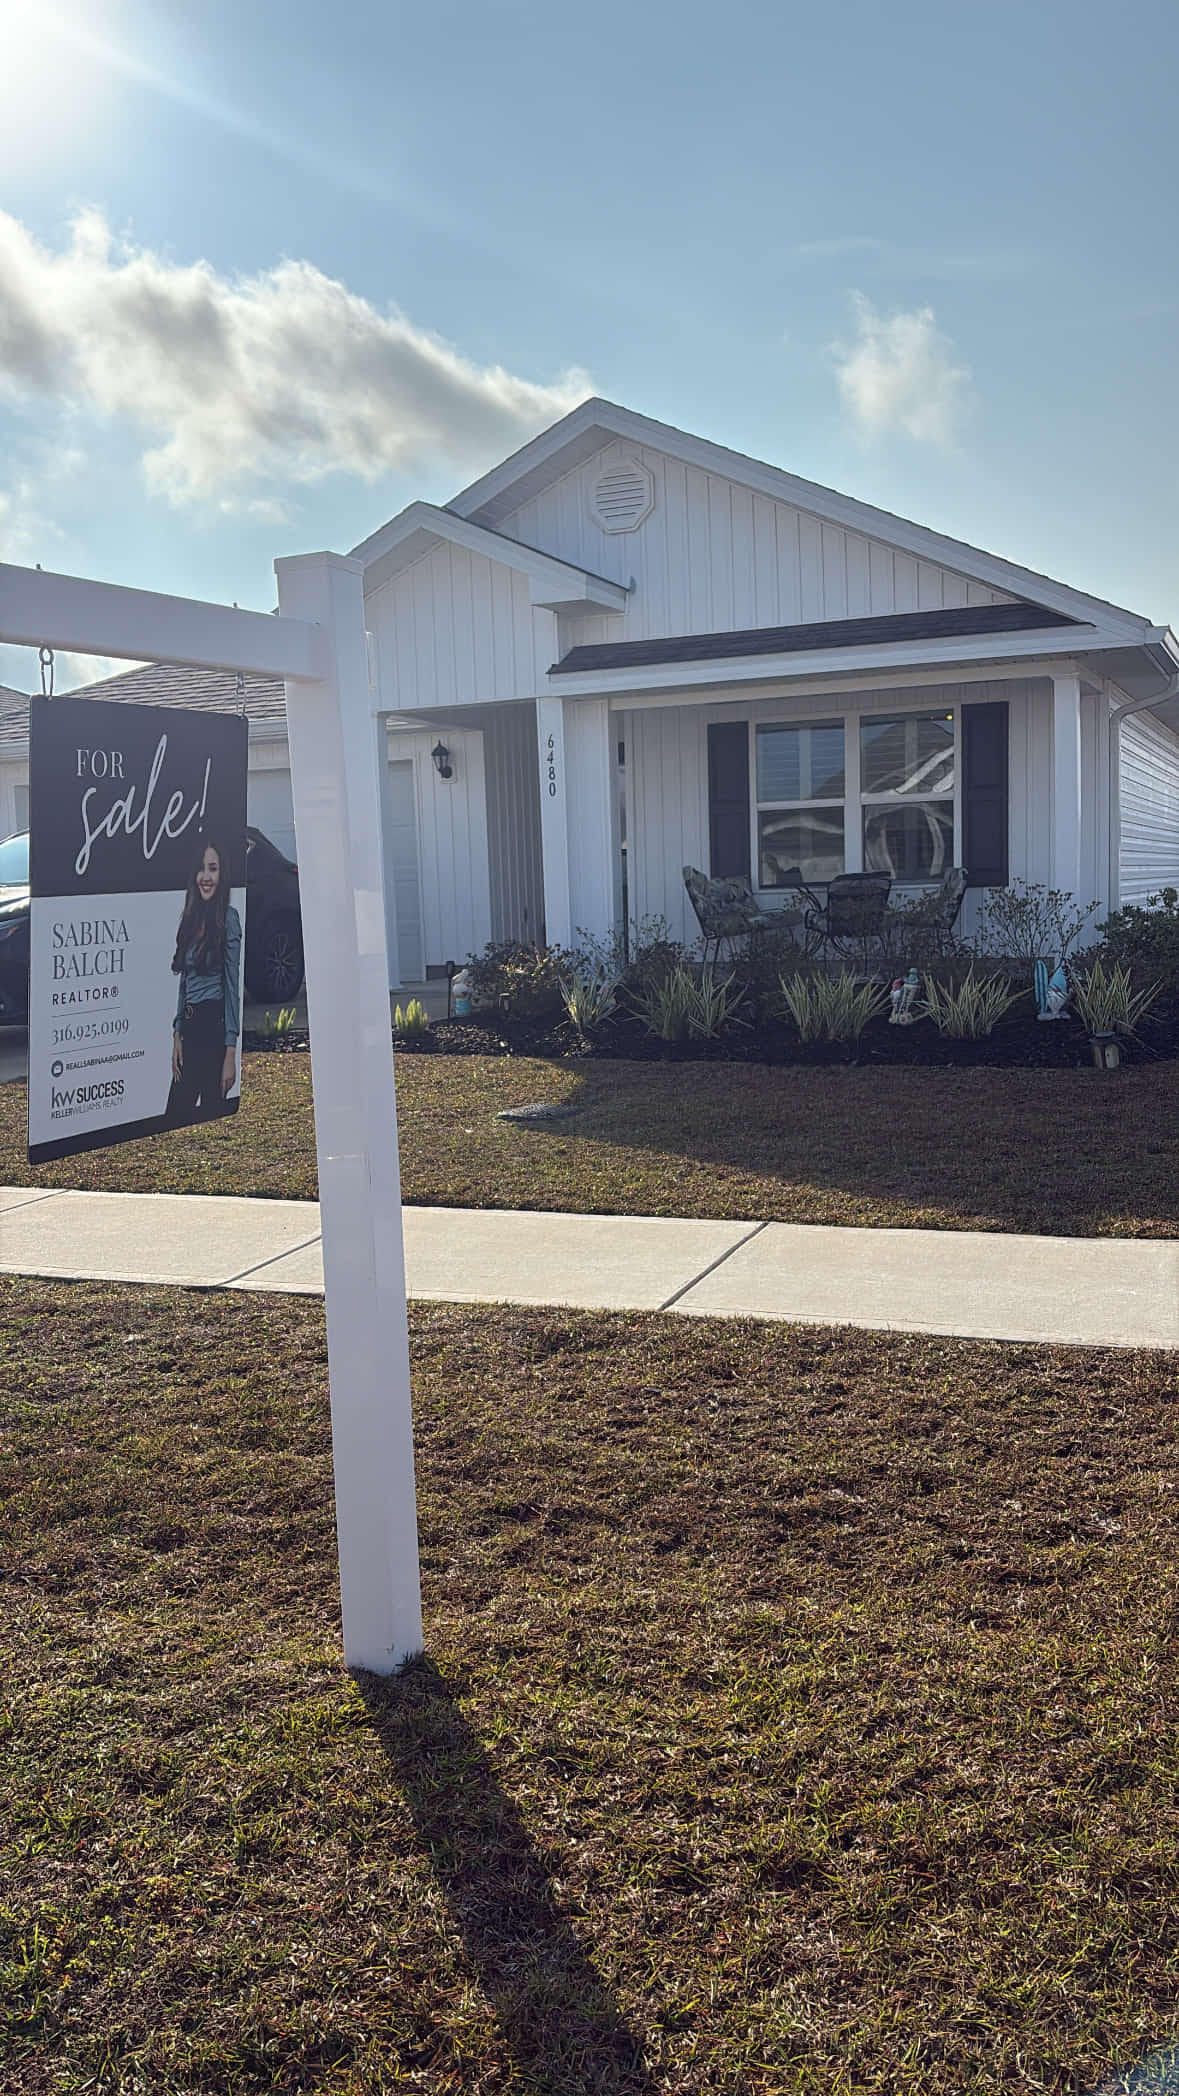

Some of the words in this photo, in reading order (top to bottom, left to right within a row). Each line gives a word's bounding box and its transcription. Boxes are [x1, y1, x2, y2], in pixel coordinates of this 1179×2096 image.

[75, 748, 126, 779] FOR
[546, 733, 556, 797] 6480
[75, 734, 212, 875] sale!
[52, 919, 130, 949] SABINA
[52, 948, 125, 980] BALCH
[51, 1018, 129, 1046] 316.925.0199
[76, 1079, 125, 1104] SUCCESS
